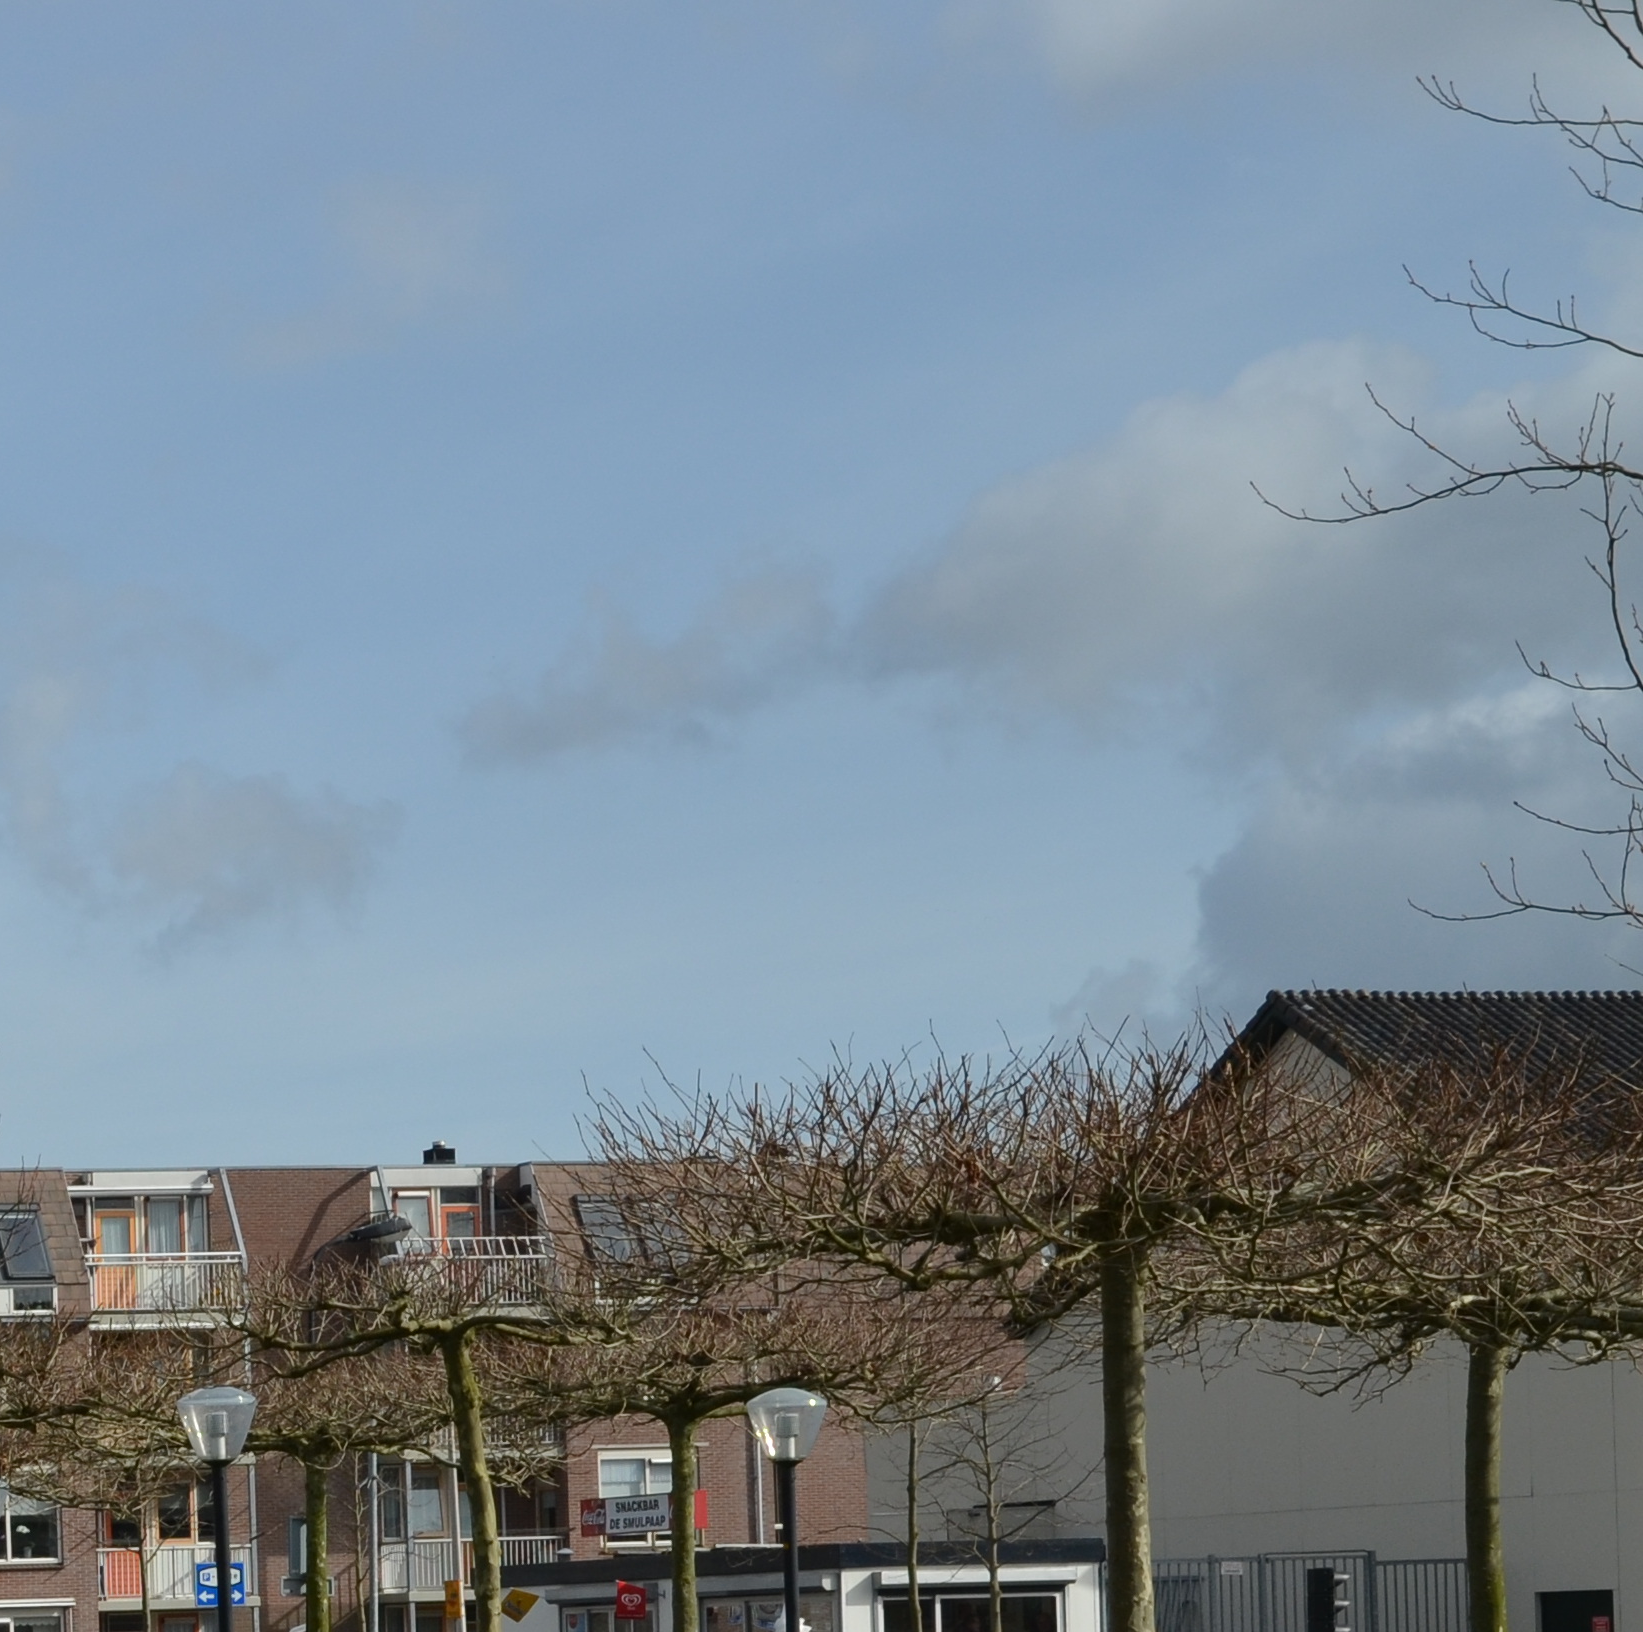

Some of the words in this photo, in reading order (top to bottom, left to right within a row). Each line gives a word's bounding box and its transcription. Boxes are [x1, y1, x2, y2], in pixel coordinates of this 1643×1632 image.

[615, 1499, 660, 1513] SNACKBAR
[609, 1518, 620, 1530] DE
[622, 1514, 666, 1529] SMULPAAP
